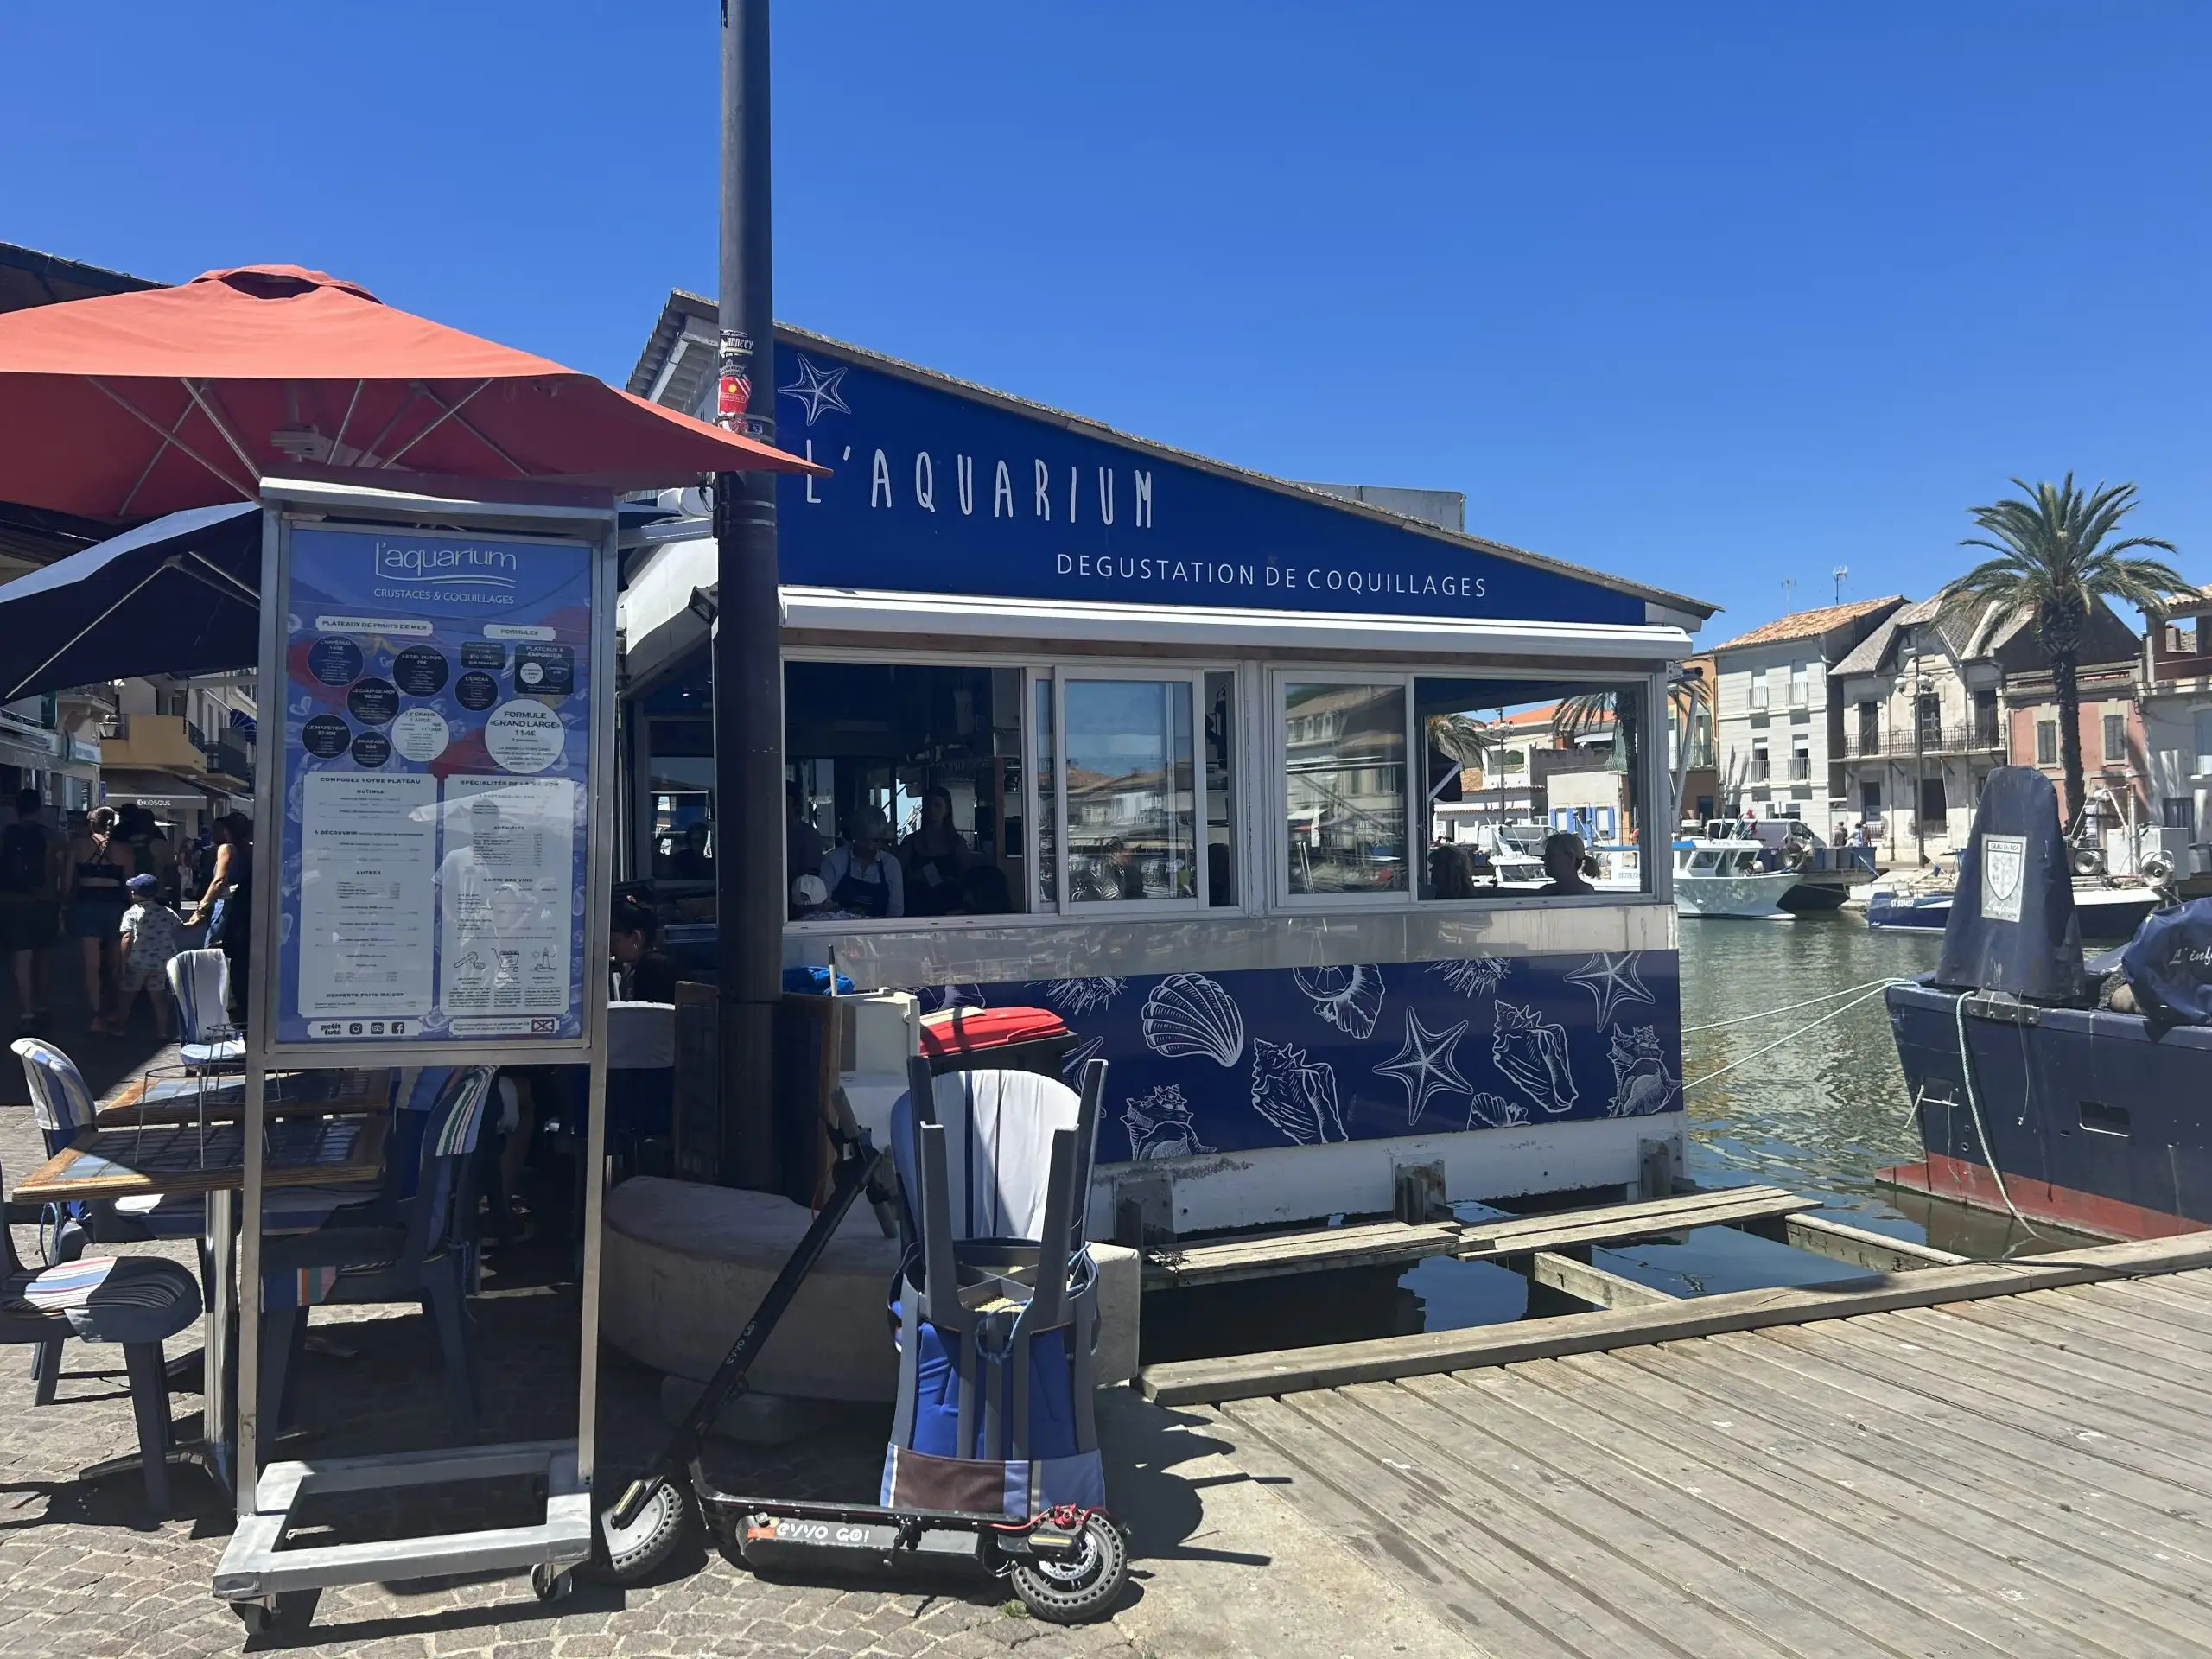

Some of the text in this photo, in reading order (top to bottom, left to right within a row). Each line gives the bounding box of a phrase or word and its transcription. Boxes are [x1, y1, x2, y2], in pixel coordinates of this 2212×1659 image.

[805, 439, 1153, 529] L'AQUARIUM
[375, 542, 517, 576] l'aquarium
[1057, 553, 1487, 598] DEGUSTATION DE COQUILLAGES
[373, 588, 515, 605] CRUSTACÉS & COQUILLAGES
[321, 620, 360, 628] PLATEAUX
[500, 628, 539, 637] FORMULES
[504, 710, 547, 719] FORMULE
